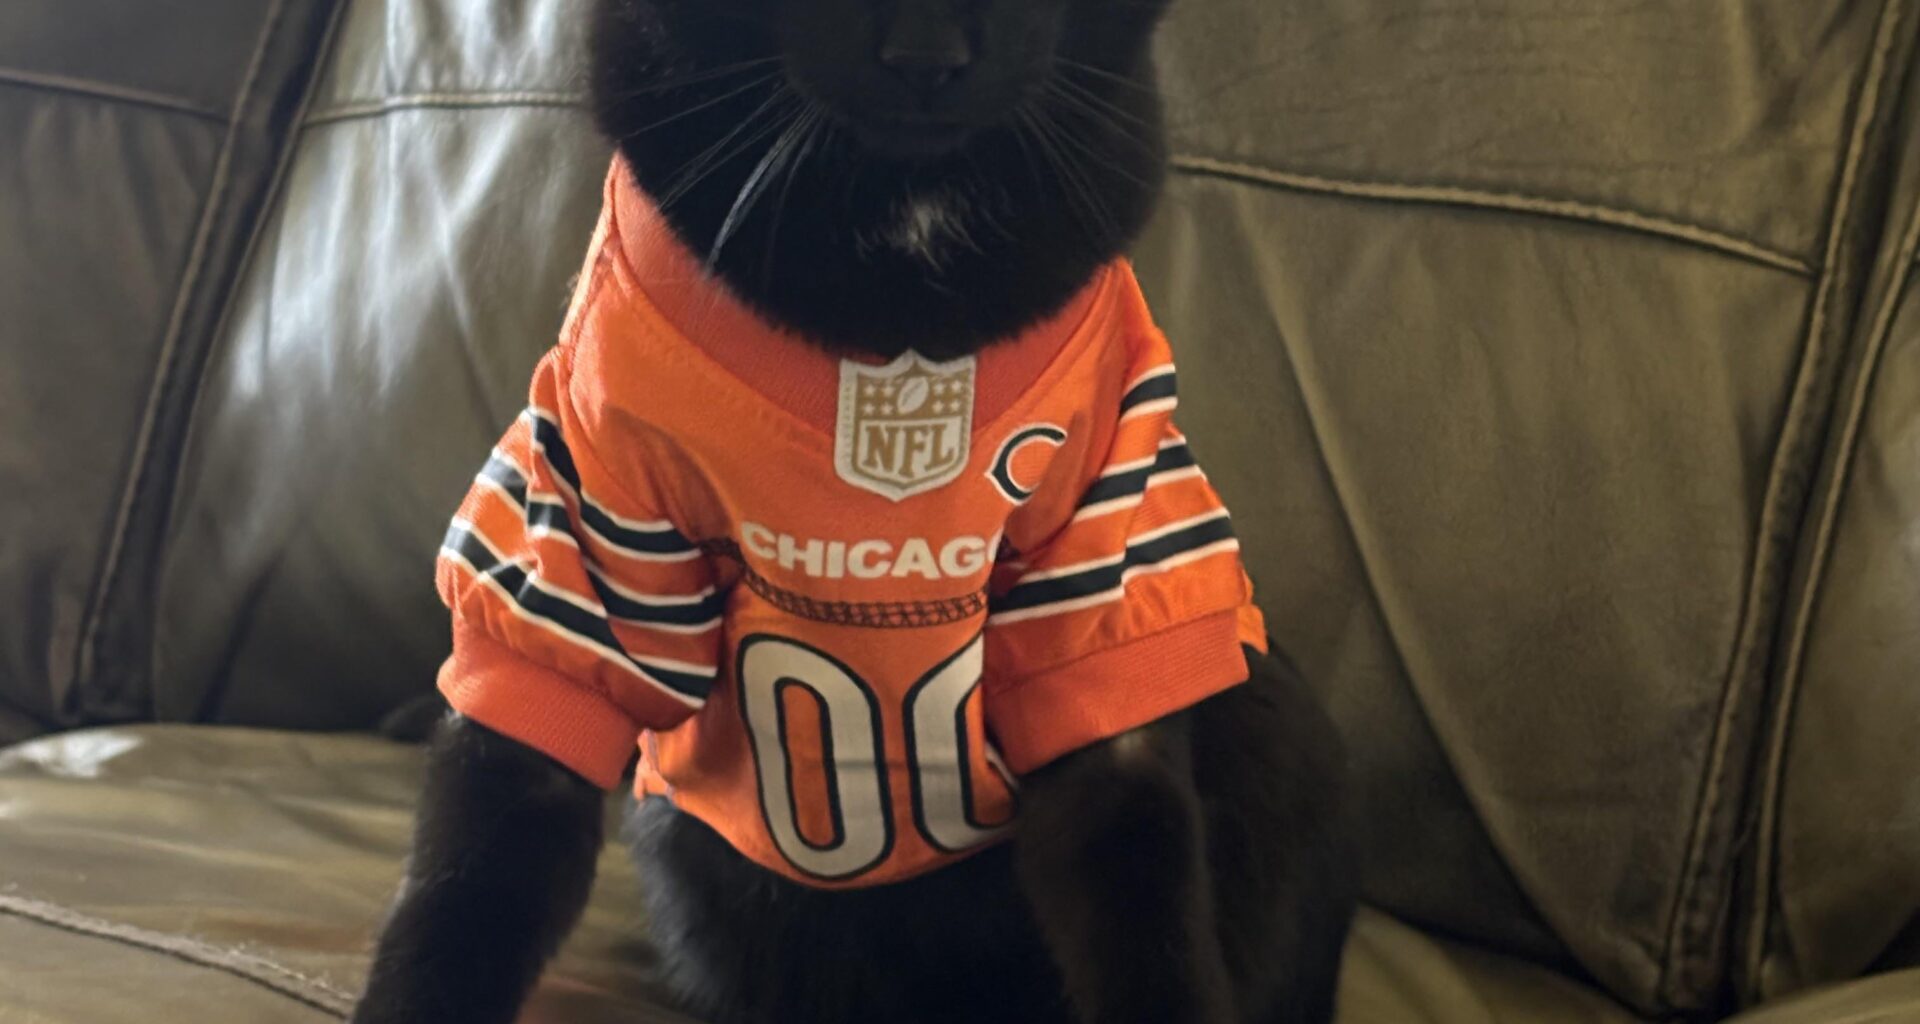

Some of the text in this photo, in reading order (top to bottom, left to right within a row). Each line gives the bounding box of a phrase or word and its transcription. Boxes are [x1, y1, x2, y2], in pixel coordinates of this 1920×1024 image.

[863, 422, 955, 478] NFL
[985, 422, 1067, 506] C
[741, 521, 1003, 579] CHICAG
